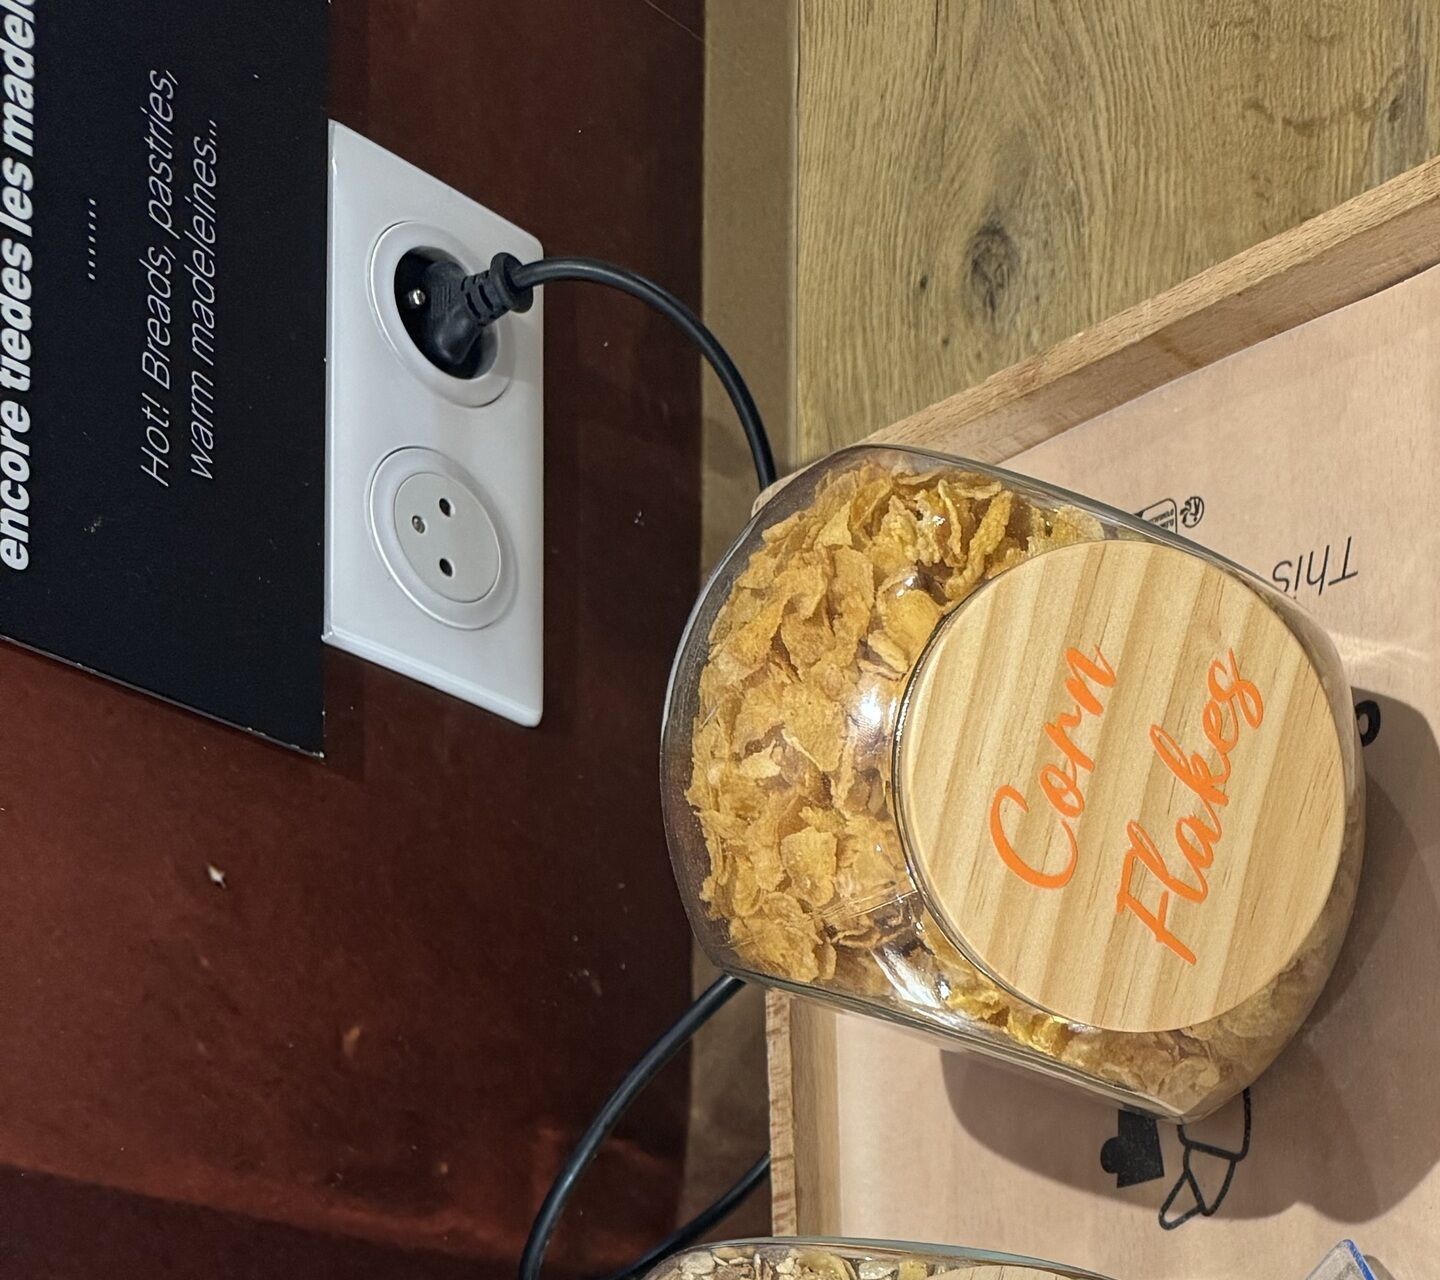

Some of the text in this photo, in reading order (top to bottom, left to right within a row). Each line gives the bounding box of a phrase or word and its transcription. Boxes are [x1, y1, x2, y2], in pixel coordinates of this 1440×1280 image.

[0, 0, 36, 157] madel
[0, 157, 34, 237] les
[139, 68, 179, 487] Hot! Breads, pastries,
[184, 118, 217, 480] warm madeleines...
[0, 400, 31, 570] encore
[1271, 534, 1359, 600] This
[988, 644, 1115, 890] Corn
[1115, 648, 1264, 966] Flakes
